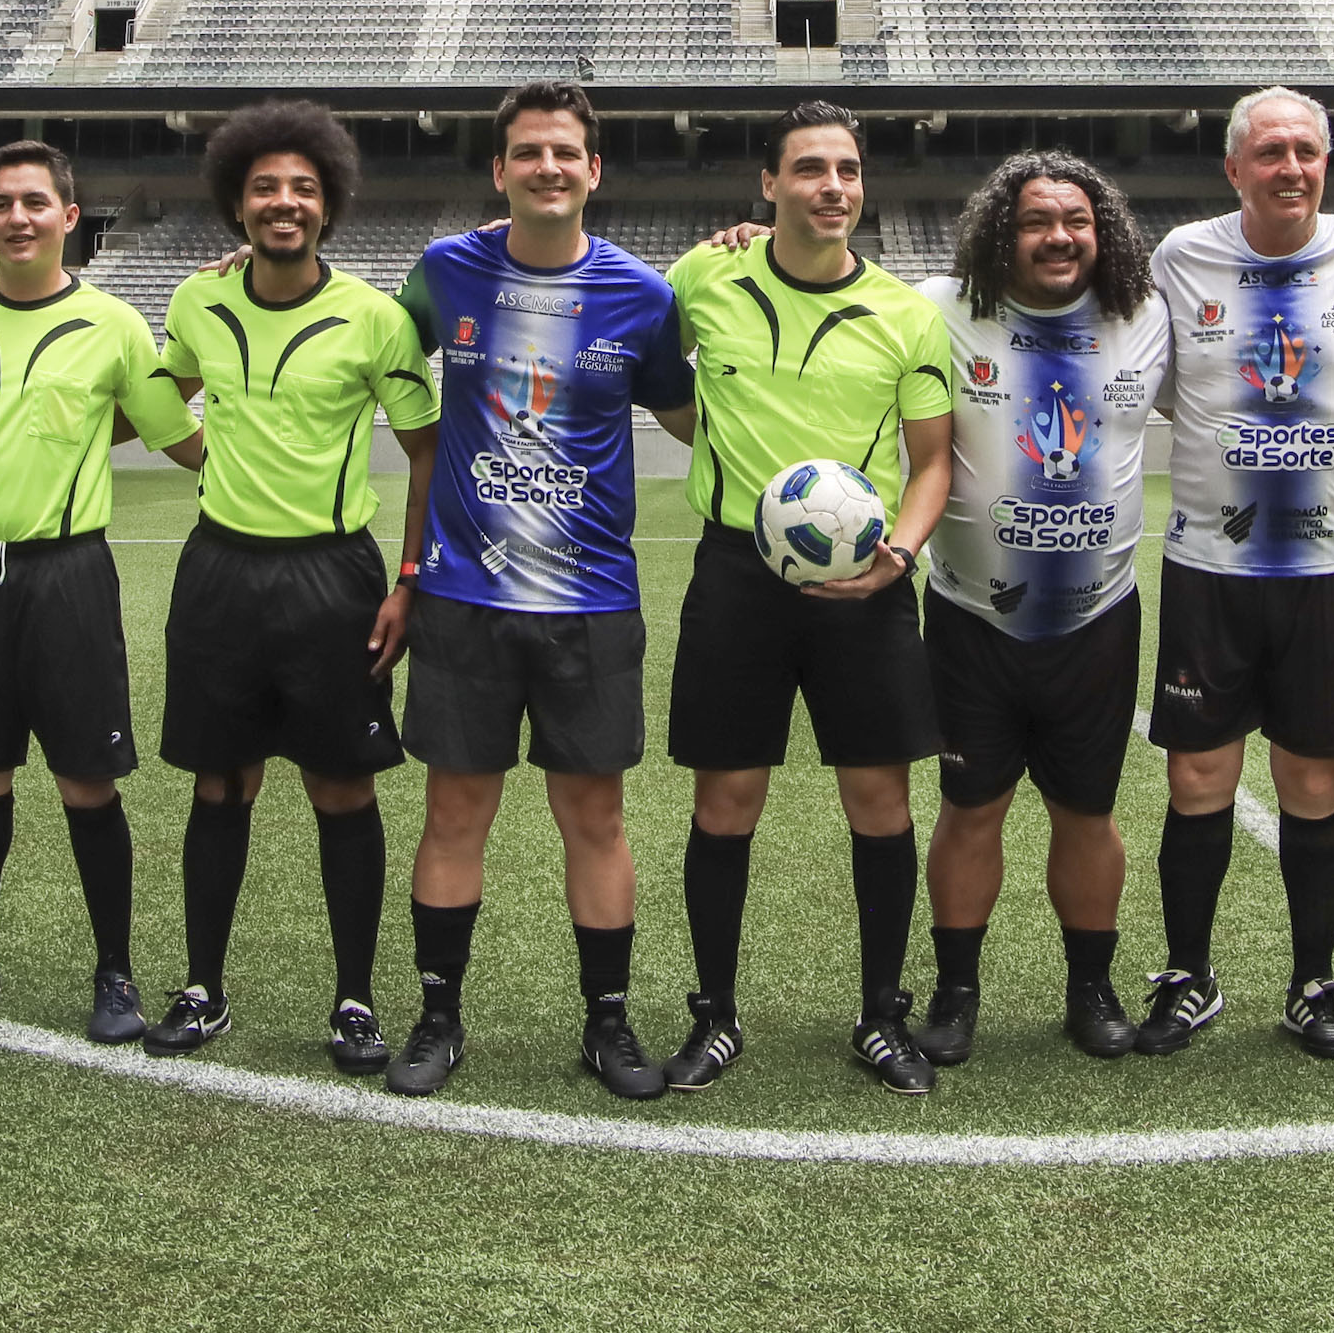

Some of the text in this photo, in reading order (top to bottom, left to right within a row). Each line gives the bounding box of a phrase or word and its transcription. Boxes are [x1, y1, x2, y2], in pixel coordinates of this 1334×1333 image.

[494, 291, 566, 313] ASCMC
[574, 360, 623, 372] LEGISLATIVA
[575, 350, 624, 364] ASSEMBLEIA
[1004, 392, 1011, 401] DE
[1102, 383, 1145, 393] ASSEMBLEIA
[1103, 392, 1145, 402] LEGISLATIVA
[1225, 446, 1334, 467] da Sorte
[474, 455, 585, 485] Esportes
[478, 480, 580, 505] da Sorte
[994, 500, 1116, 529] Esportes
[999, 526, 1110, 548] da Sorte
